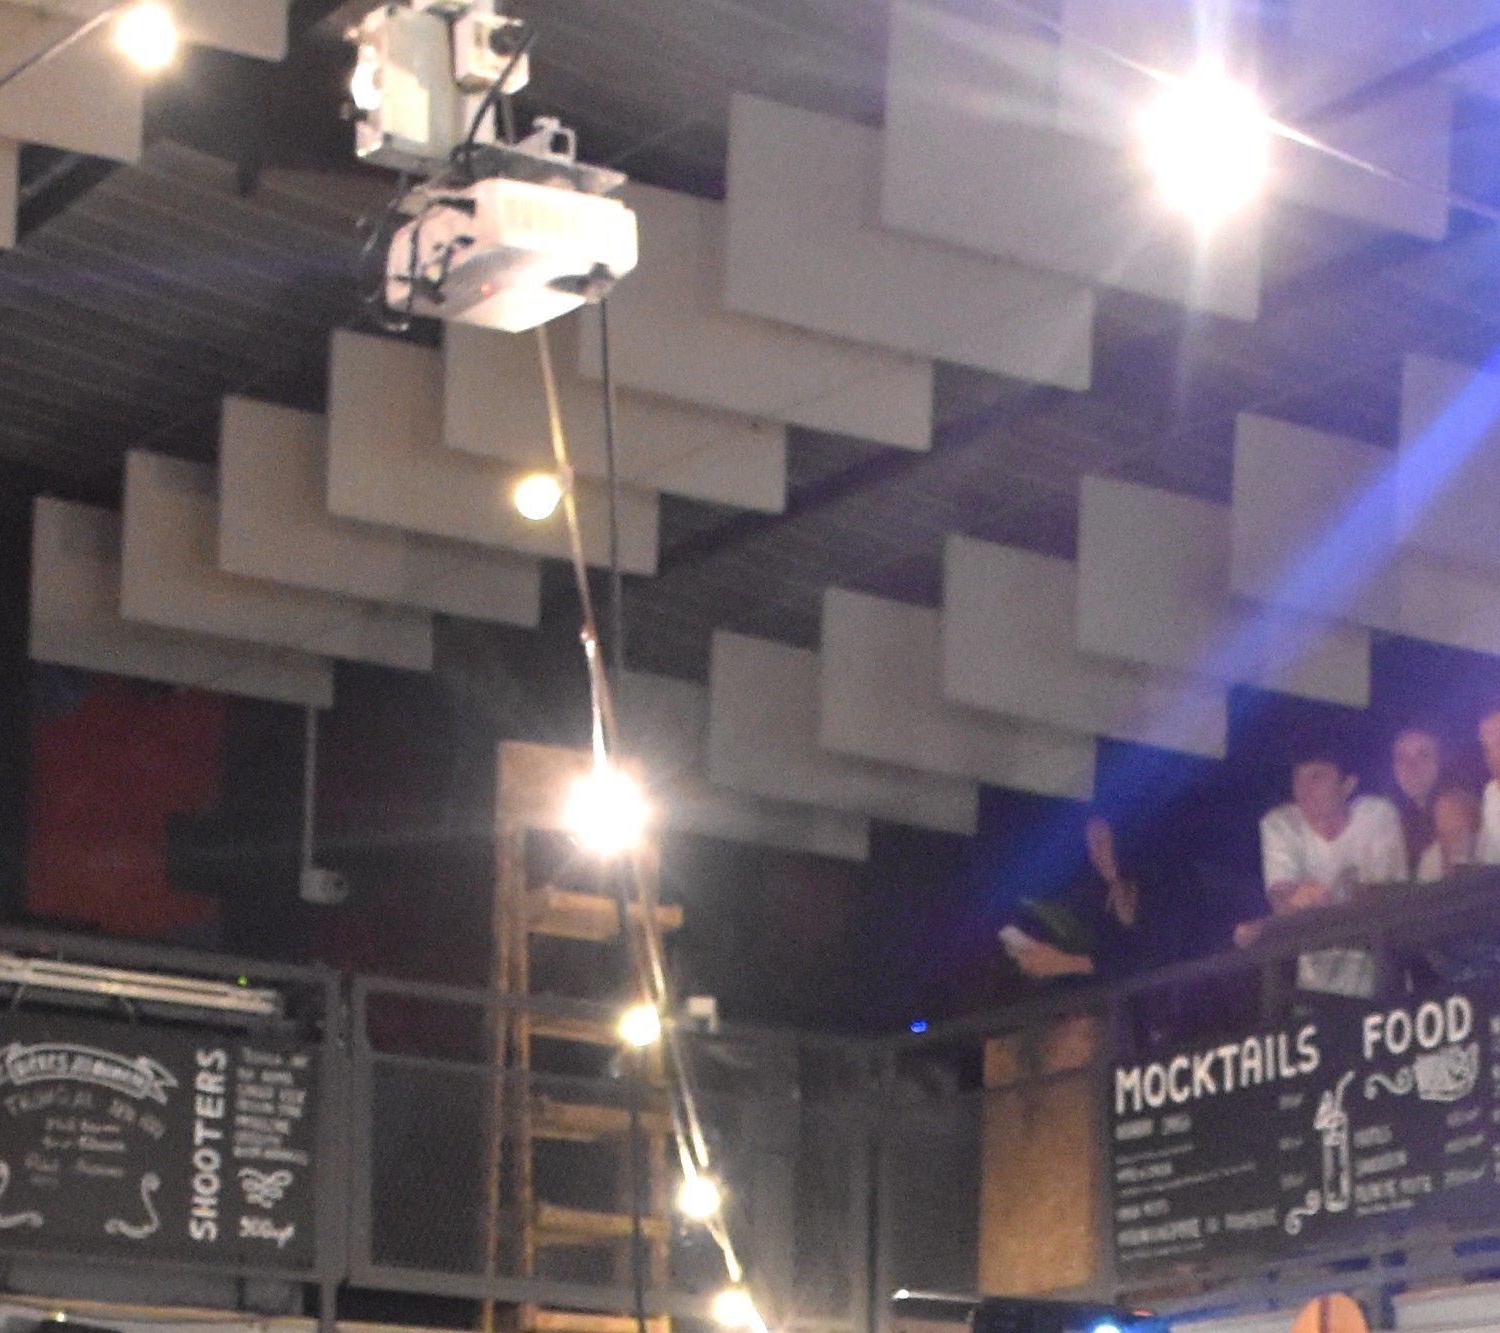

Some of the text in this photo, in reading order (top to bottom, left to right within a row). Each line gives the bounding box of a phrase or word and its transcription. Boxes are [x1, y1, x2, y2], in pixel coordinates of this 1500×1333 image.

[1115, 1024, 1321, 1115] MOCKTAILS
[1363, 995, 1473, 1060] FOOD
[189, 1049, 228, 1242] SHOOTERS
